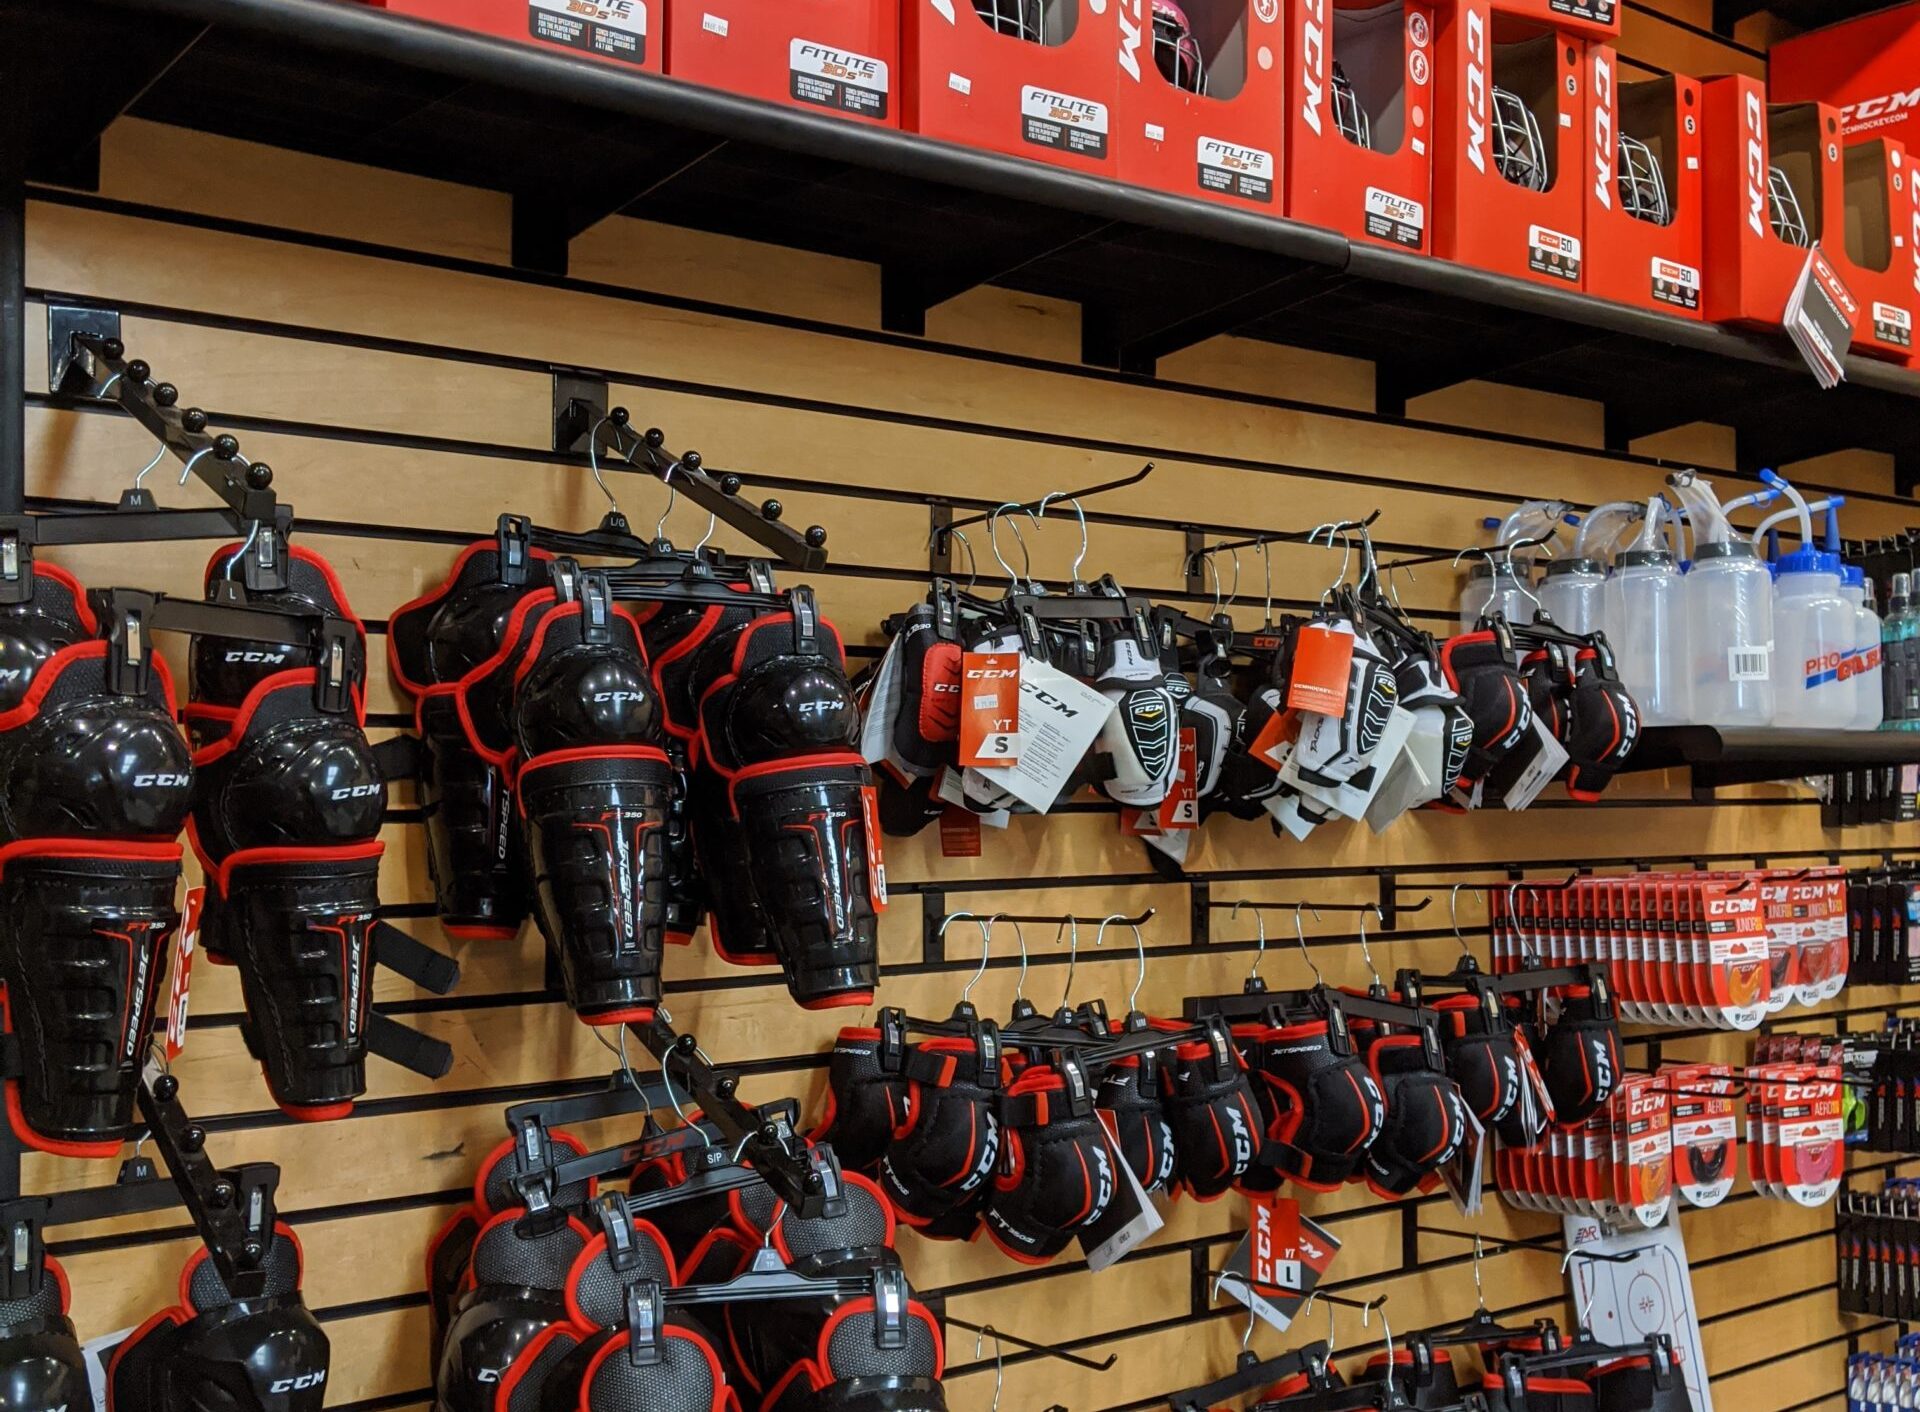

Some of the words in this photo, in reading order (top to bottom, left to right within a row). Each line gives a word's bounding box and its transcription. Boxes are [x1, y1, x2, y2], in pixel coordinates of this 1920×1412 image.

[800, 44, 878, 73] FITLITE
[1467, 8, 1485, 175] CCM
[1568, 78, 1576, 92] S
[1030, 91, 1099, 116] FITLITE
[1595, 56, 1611, 211] CCM
[1687, 118, 1694, 132] S
[1205, 141, 1265, 164] FITLITE
[1746, 90, 1764, 240] CCM
[1371, 192, 1417, 214] FITLITE
[1539, 234, 1559, 247] CCM
[1561, 238, 1572, 253] 50
[1681, 268, 1692, 283] 50
[1815, 260, 1856, 313] CCM
[130, 495, 142, 506] M
[610, 517, 625, 528] L/G
[230, 587, 236, 600] L
[225, 652, 286, 665] CCM
[1805, 651, 1842, 675] PRO
[967, 669, 1018, 679] CCM
[594, 691, 645, 703] CCM
[934, 683, 960, 693] CC
[797, 701, 844, 713] CCM
[1019, 679, 1079, 718] CCM
[1134, 704, 1164, 715] CCM
[1502, 682, 1532, 750] CCM
[993, 719, 1012, 731] YT
[1616, 692, 1638, 759] CCM
[994, 736, 1009, 754] S
[133, 773, 190, 788] CCM
[332, 783, 381, 801] CCM
[1181, 788, 1194, 799] YT
[1183, 803, 1193, 819] S
[1761, 886, 1789, 901] CM
[1709, 898, 1758, 915] CCM
[126, 922, 166, 933] FT350
[349, 935, 361, 1034] JETSPEED
[125, 944, 149, 1057] JETSPEED
[1271, 1044, 1322, 1056] JETSPEED
[1593, 1039, 1612, 1102] CCM
[1493, 1055, 1519, 1121] CCM
[1784, 1083, 1837, 1101] CCM
[1363, 1076, 1384, 1149] CCM
[1631, 1094, 1666, 1116] CCM
[1438, 1091, 1466, 1165] CCM
[622, 1133, 685, 1162] CCM
[1226, 1106, 1251, 1176] CCM
[707, 1151, 723, 1164] S/P
[959, 1111, 1000, 1192] CCM
[136, 1165, 147, 1178] M
[1082, 1145, 1112, 1226] CCM
[1257, 1204, 1271, 1283] CCM
[1285, 1248, 1295, 1258] YT
[1286, 1265, 1294, 1283] L
[270, 1369, 326, 1394] CCM
